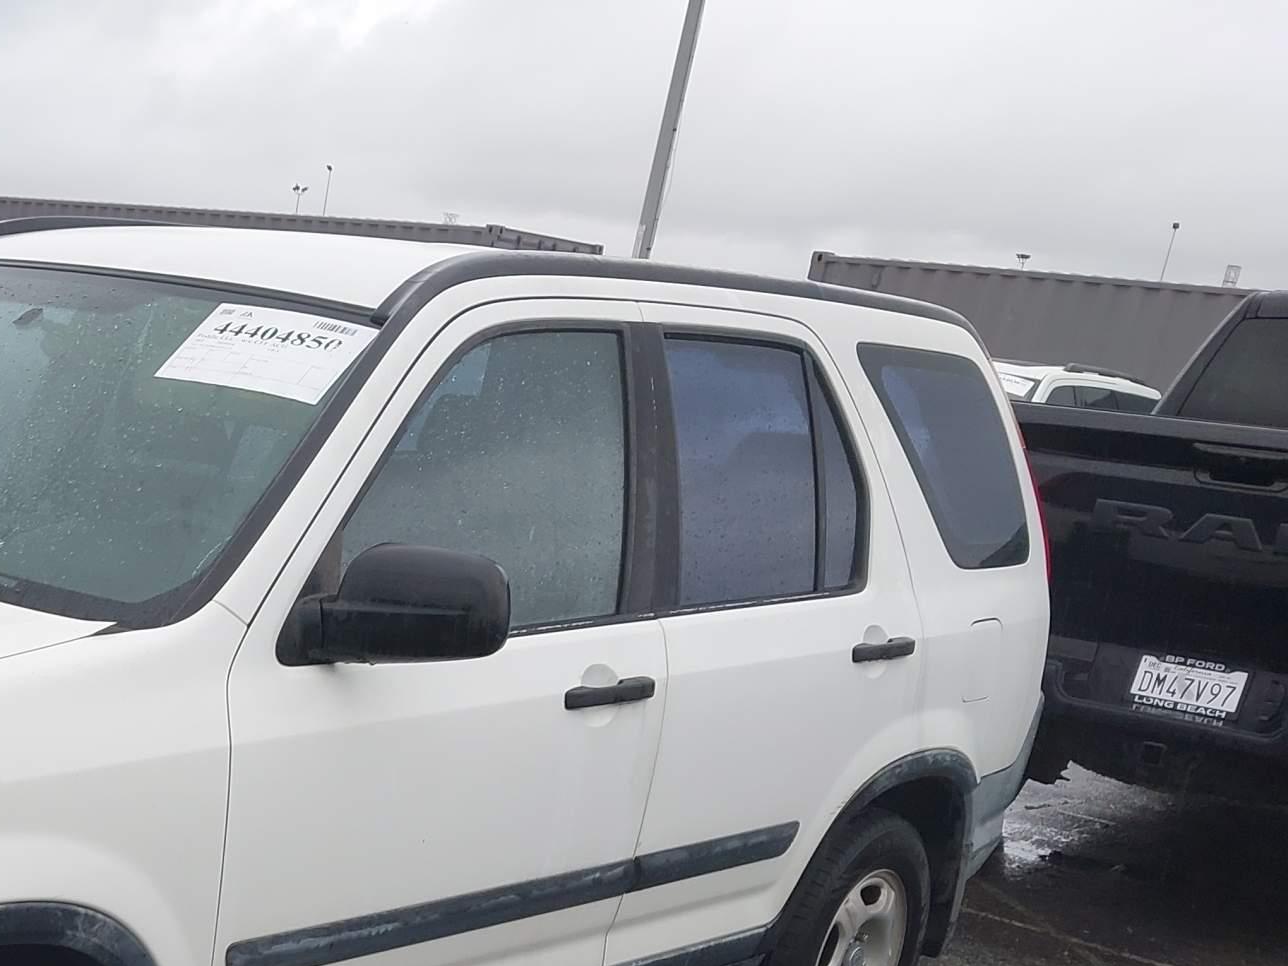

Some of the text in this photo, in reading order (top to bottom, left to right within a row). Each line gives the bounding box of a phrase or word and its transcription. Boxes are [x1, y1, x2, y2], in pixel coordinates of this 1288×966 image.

[213, 321, 343, 353] 44404850
[1093, 498, 1288, 555] RA
[1165, 655, 1226, 671] BP FORD
[1138, 671, 1237, 707] DM47V97
[1134, 695, 1175, 709] LONG
[1177, 704, 1226, 718] BEACH
